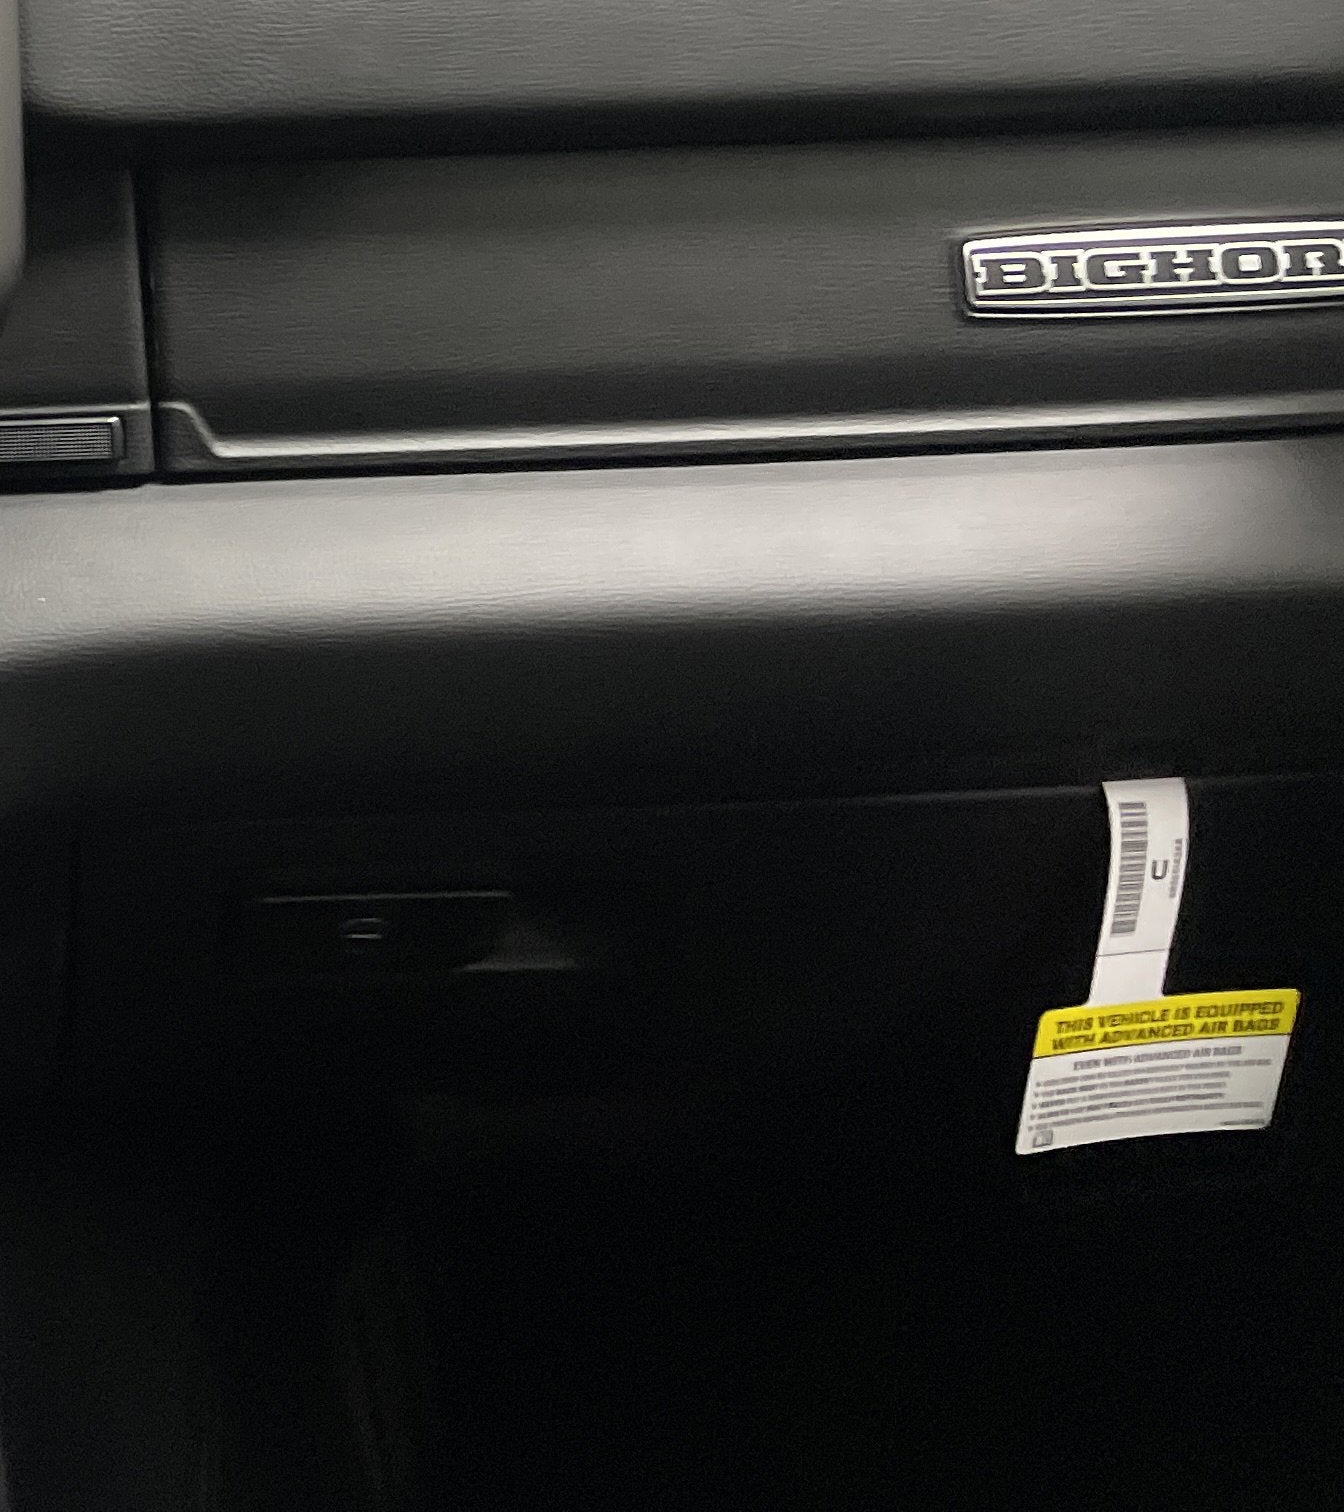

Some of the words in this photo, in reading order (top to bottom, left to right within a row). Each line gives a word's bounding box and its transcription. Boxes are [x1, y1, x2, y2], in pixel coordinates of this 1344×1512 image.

[972, 238, 1344, 296] BIGHOR
[1051, 1034, 1096, 1051] WITH
[1099, 1023, 1194, 1044] ADVANCED
[1199, 1019, 1228, 1034] AIR
[1231, 1017, 1280, 1032] BAGS
[1055, 1015, 1094, 1035] THIS
[1098, 1007, 1167, 1028] VEHICLE
[1174, 1005, 1191, 1021] IS
[1194, 1000, 1285, 1019] EQUIPPED
